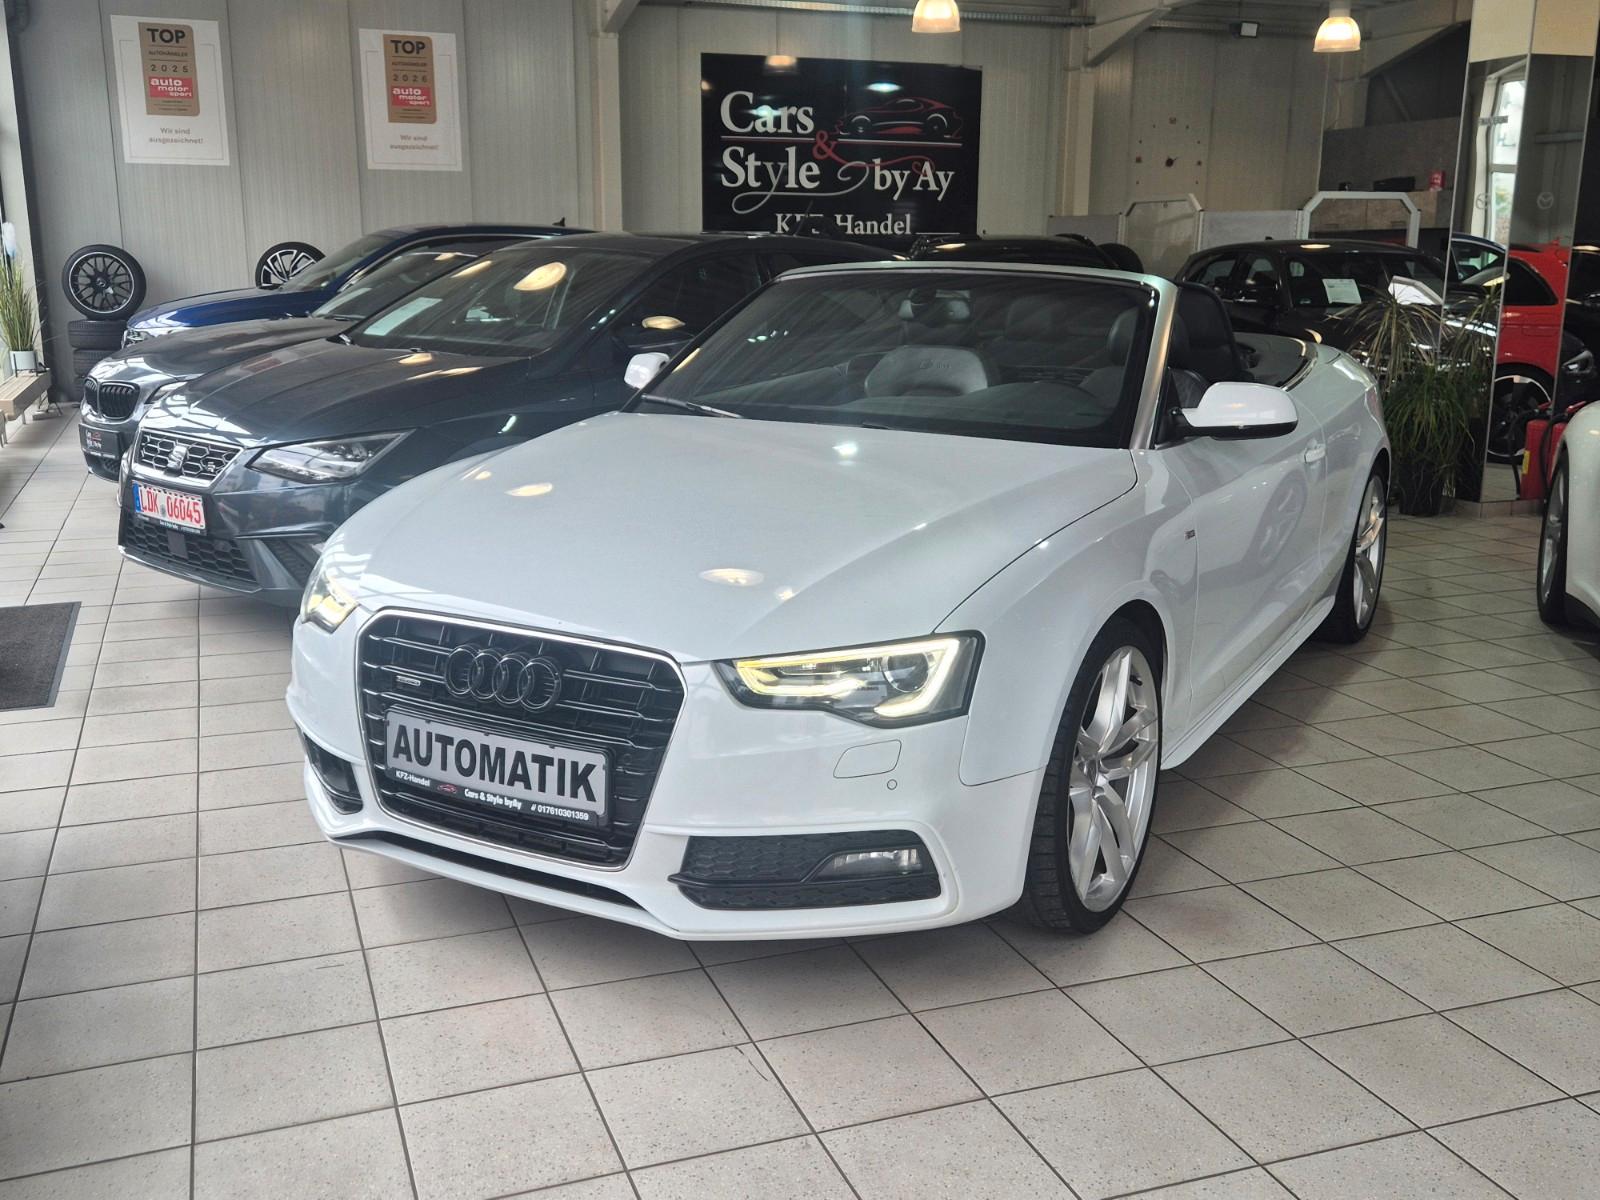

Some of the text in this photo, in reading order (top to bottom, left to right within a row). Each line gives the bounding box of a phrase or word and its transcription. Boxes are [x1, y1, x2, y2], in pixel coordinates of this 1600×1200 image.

[146, 28, 186, 44] TOP
[390, 40, 426, 55] TOP
[150, 64, 189, 73] 2025
[150, 78, 182, 86] auto
[392, 87, 422, 95] auto
[720, 91, 815, 135] Cars
[812, 130, 838, 160] &
[720, 145, 956, 213] Style by Ay
[834, 212, 912, 235] Handel
[140, 486, 202, 524] LDK 06045
[392, 724, 598, 803] AUTOMATIK
[395, 769, 431, 787] KFZ-Handel
[464, 788, 479, 799] Cars
[486, 793, 504, 806] Style
